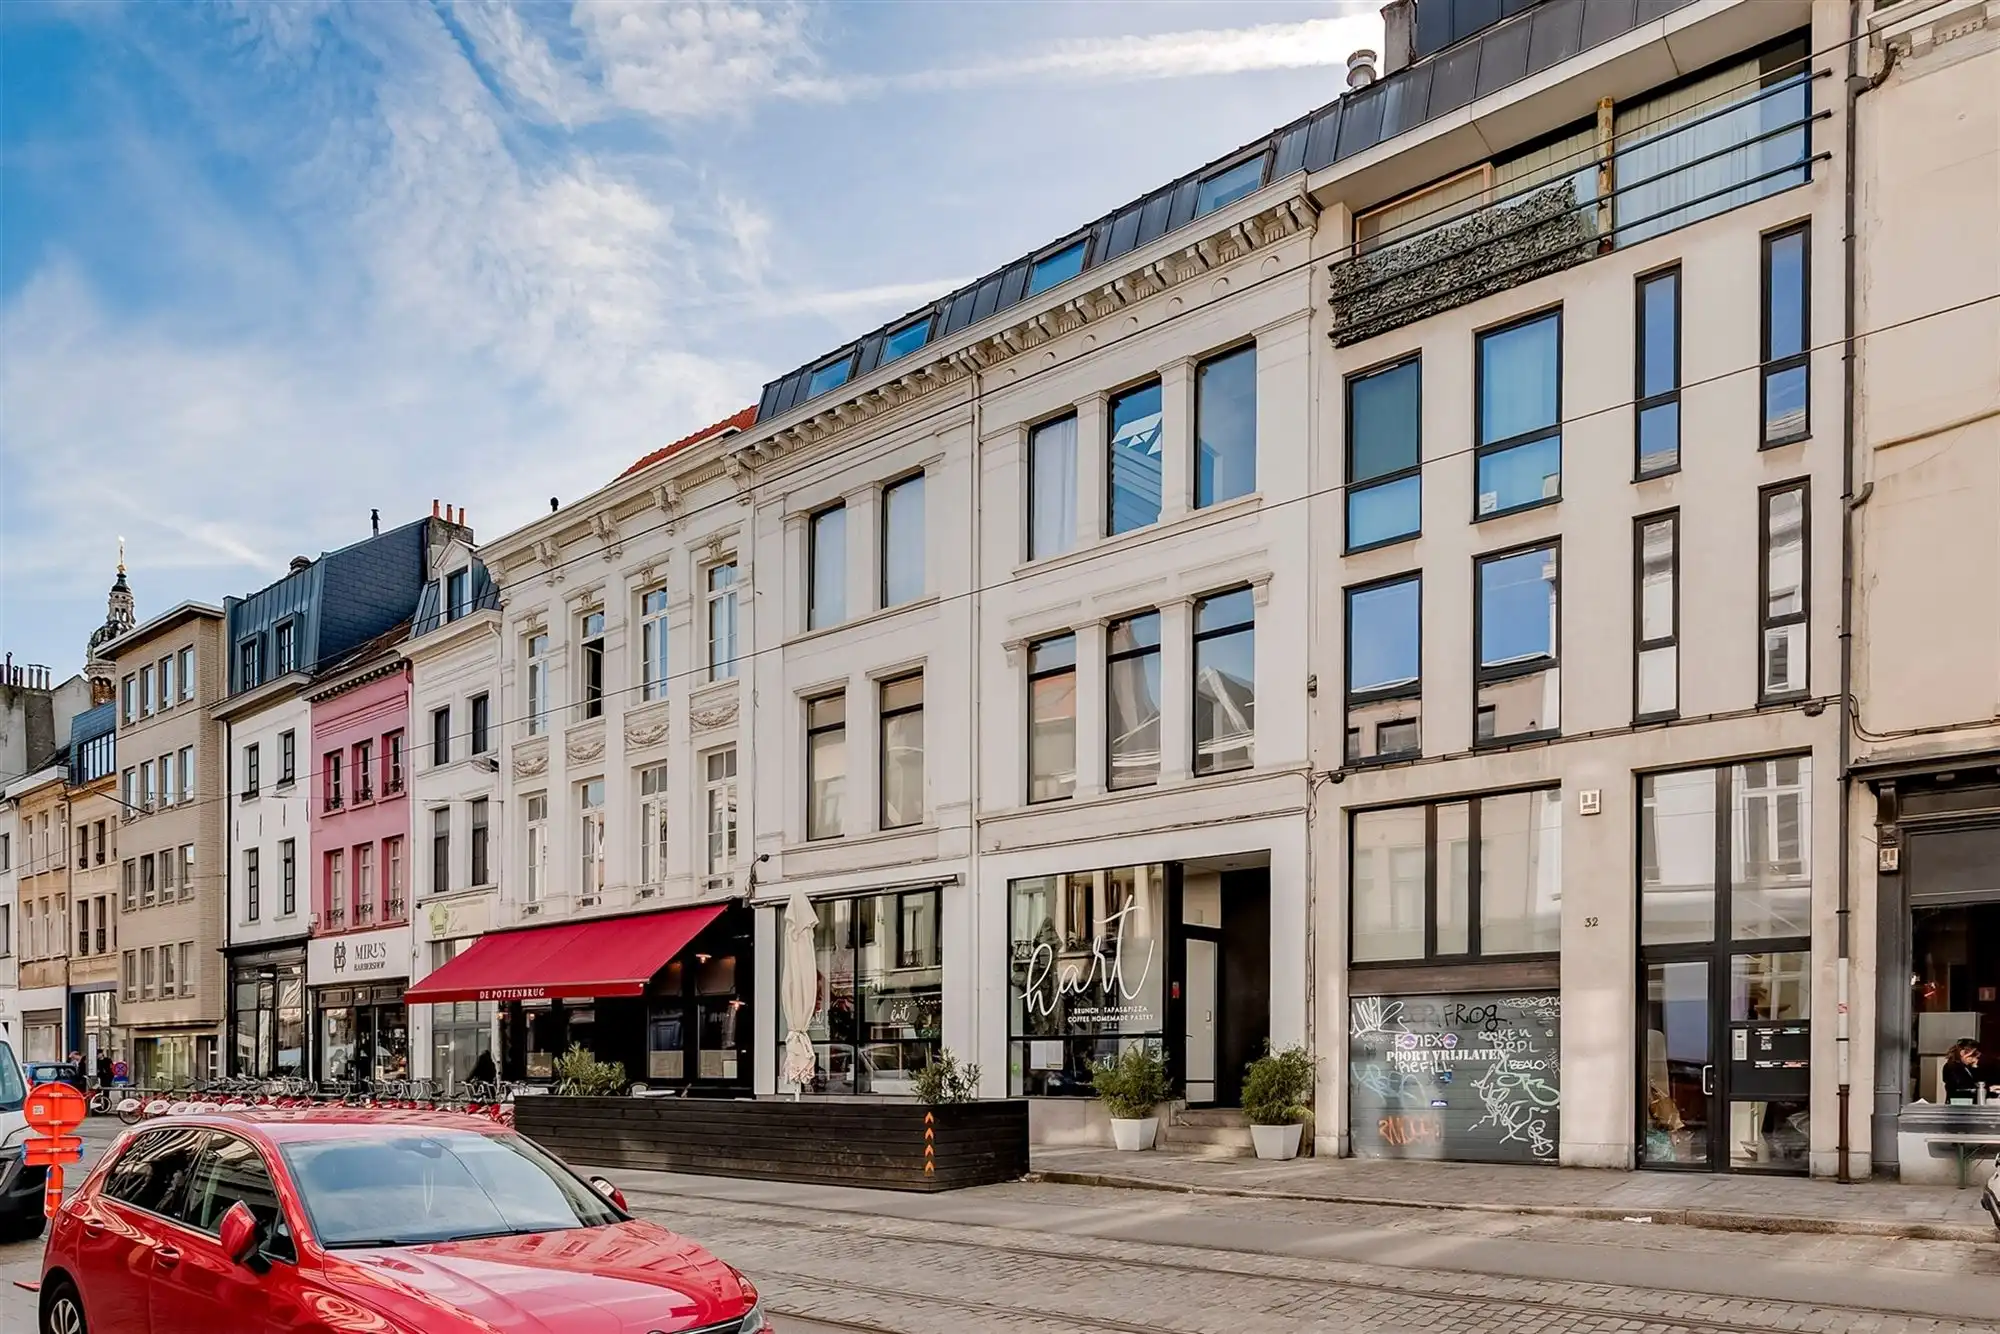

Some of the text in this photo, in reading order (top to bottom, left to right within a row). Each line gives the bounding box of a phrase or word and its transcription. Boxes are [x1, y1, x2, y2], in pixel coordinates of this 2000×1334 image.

[1584, 916, 1599, 928] 32
[1018, 894, 1154, 1016] hart
[479, 987, 545, 999] DE POTTENBRUG
[1073, 1007, 1099, 1015] BRUNCH
[1067, 1013, 1154, 1023] COFFEE HOMEMADE PASTRY
[1386, 1049, 1506, 1062] POORT VRIJLATEN
